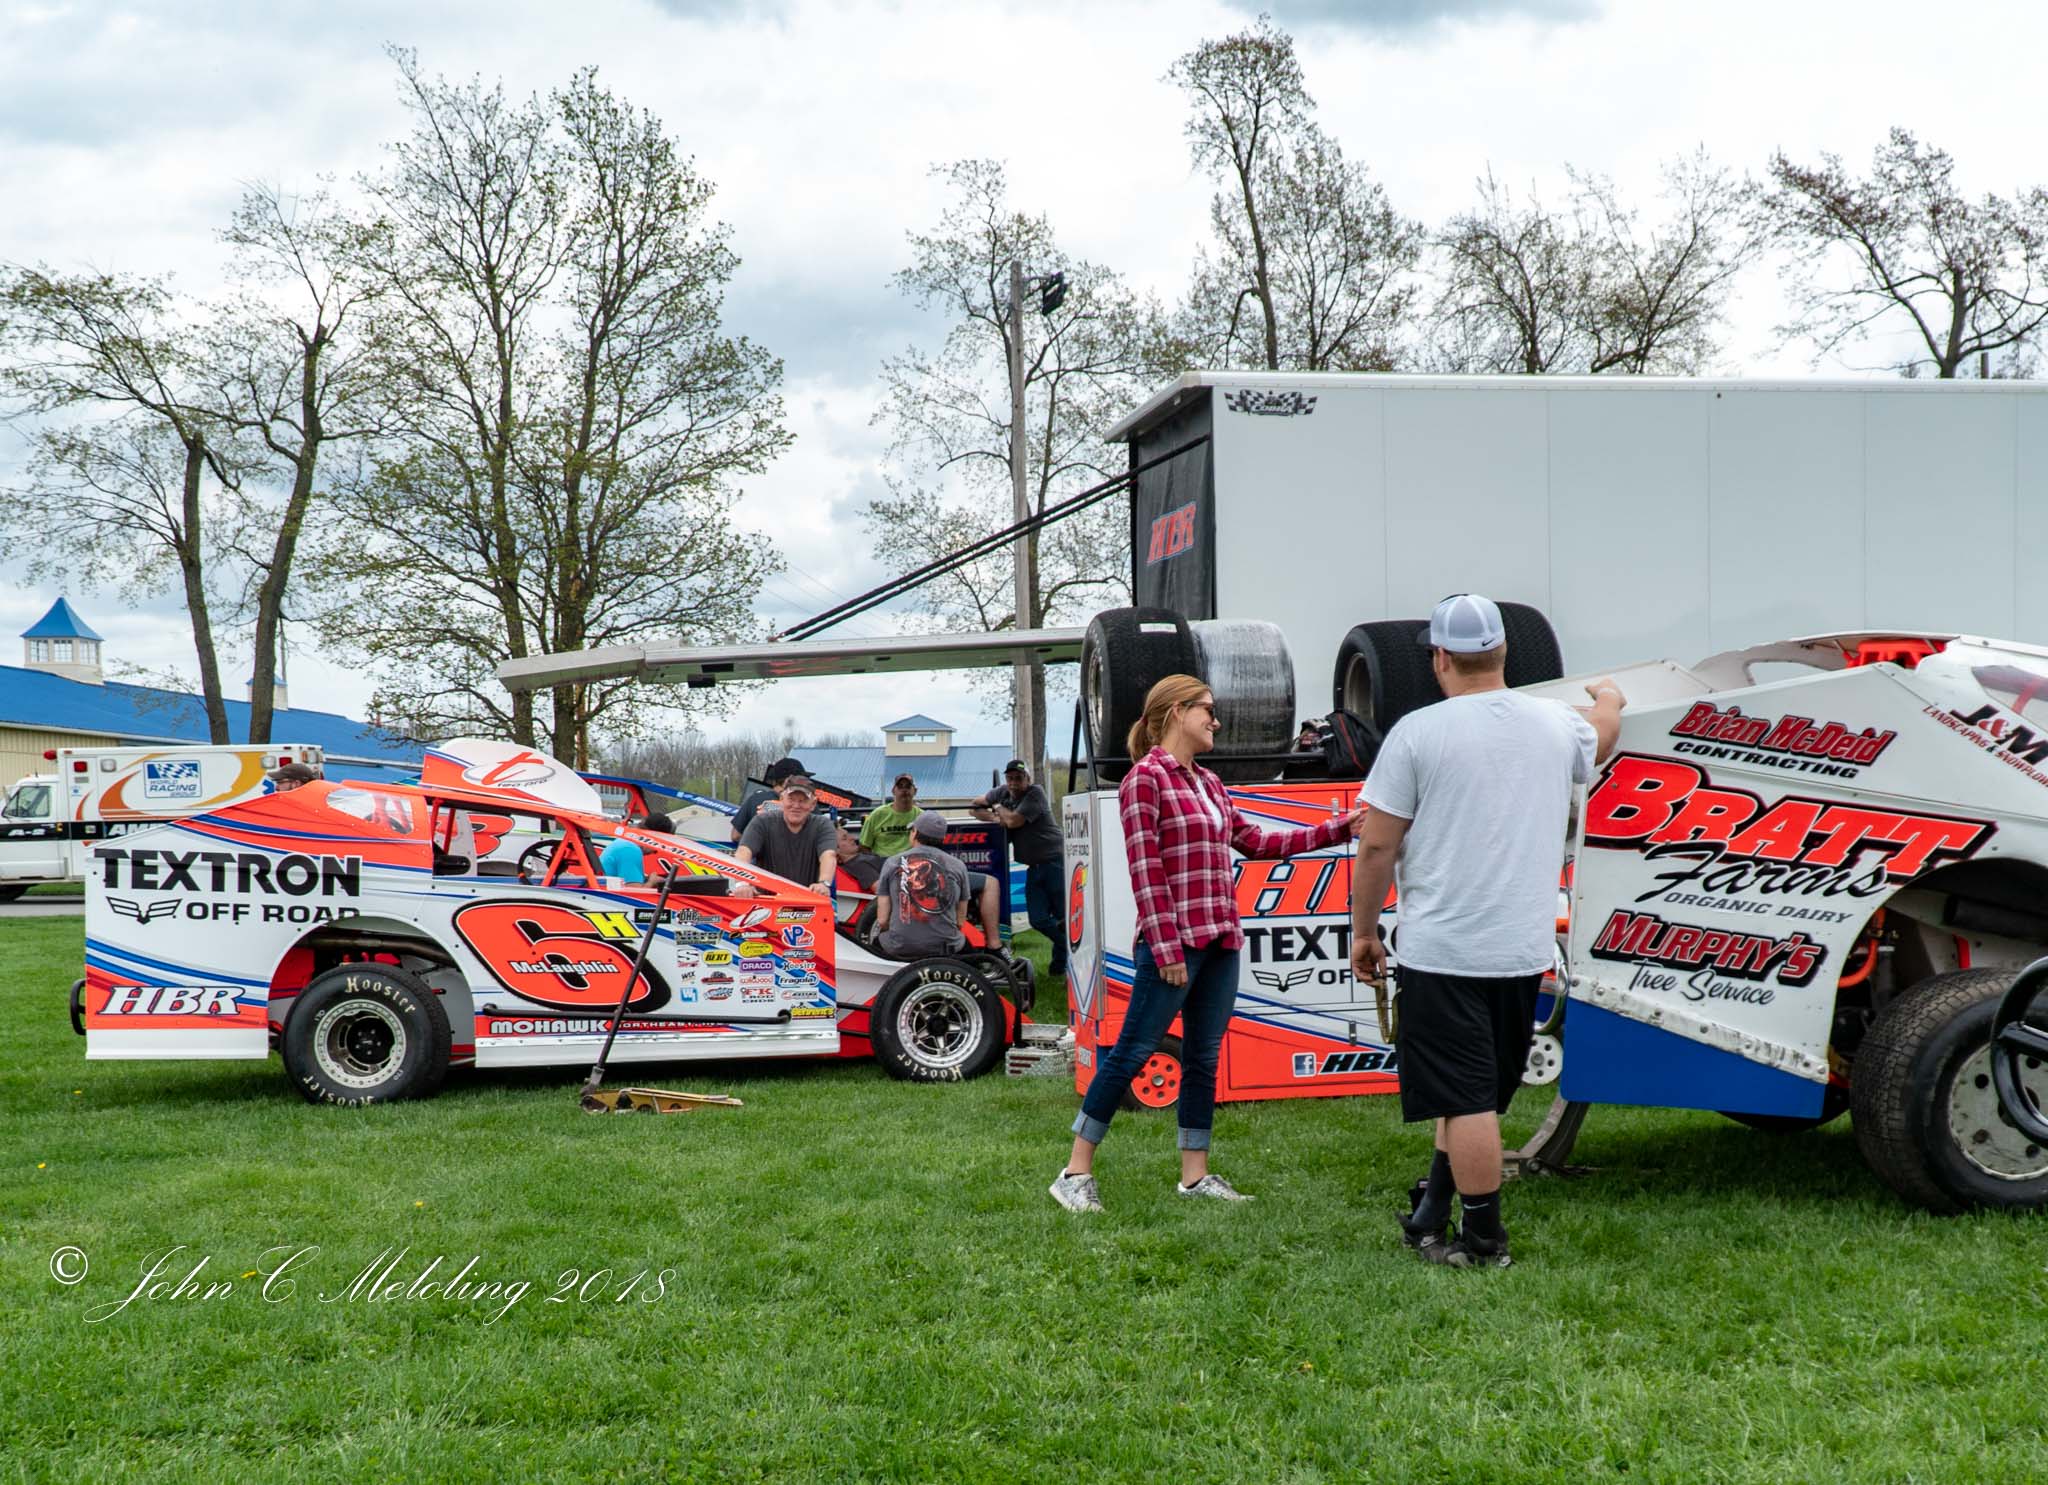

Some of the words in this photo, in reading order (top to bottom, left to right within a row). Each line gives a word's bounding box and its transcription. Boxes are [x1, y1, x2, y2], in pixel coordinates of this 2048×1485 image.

[1146, 502, 1197, 564] HBR
[1671, 702, 1761, 751] Brian
[1762, 715, 1897, 767] McDeid
[1922, 705, 1992, 749] LANDSCAPING
[1672, 742, 1860, 779] CONTRACTING
[150, 784, 197, 792] RACING
[1585, 752, 1998, 885] BRATT
[94, 848, 363, 897] TEXTRON
[1635, 842, 1893, 903] Farms
[186, 903, 250, 922] OFF
[1664, 891, 1773, 915] ORGANIC
[1775, 905, 1855, 925] DAIRY
[783, 926, 804, 946] VP
[1590, 909, 1828, 987] MURPHY'S
[508, 960, 620, 975] McLaughlin
[705, 953, 729, 961] BERT
[742, 962, 772, 970] DRACO
[782, 961, 816, 970] Hoosier
[345, 976, 416, 1013] Hoosier
[780, 977, 815, 987] Fragola
[918, 967, 984, 998] Hoosier
[1629, 958, 1677, 991] Tree
[1681, 964, 1775, 1005] Service
[96, 985, 246, 1016] HBR
[490, 1020, 607, 1035] MOHAWK
[897, 1052, 963, 1081] Hoosier
